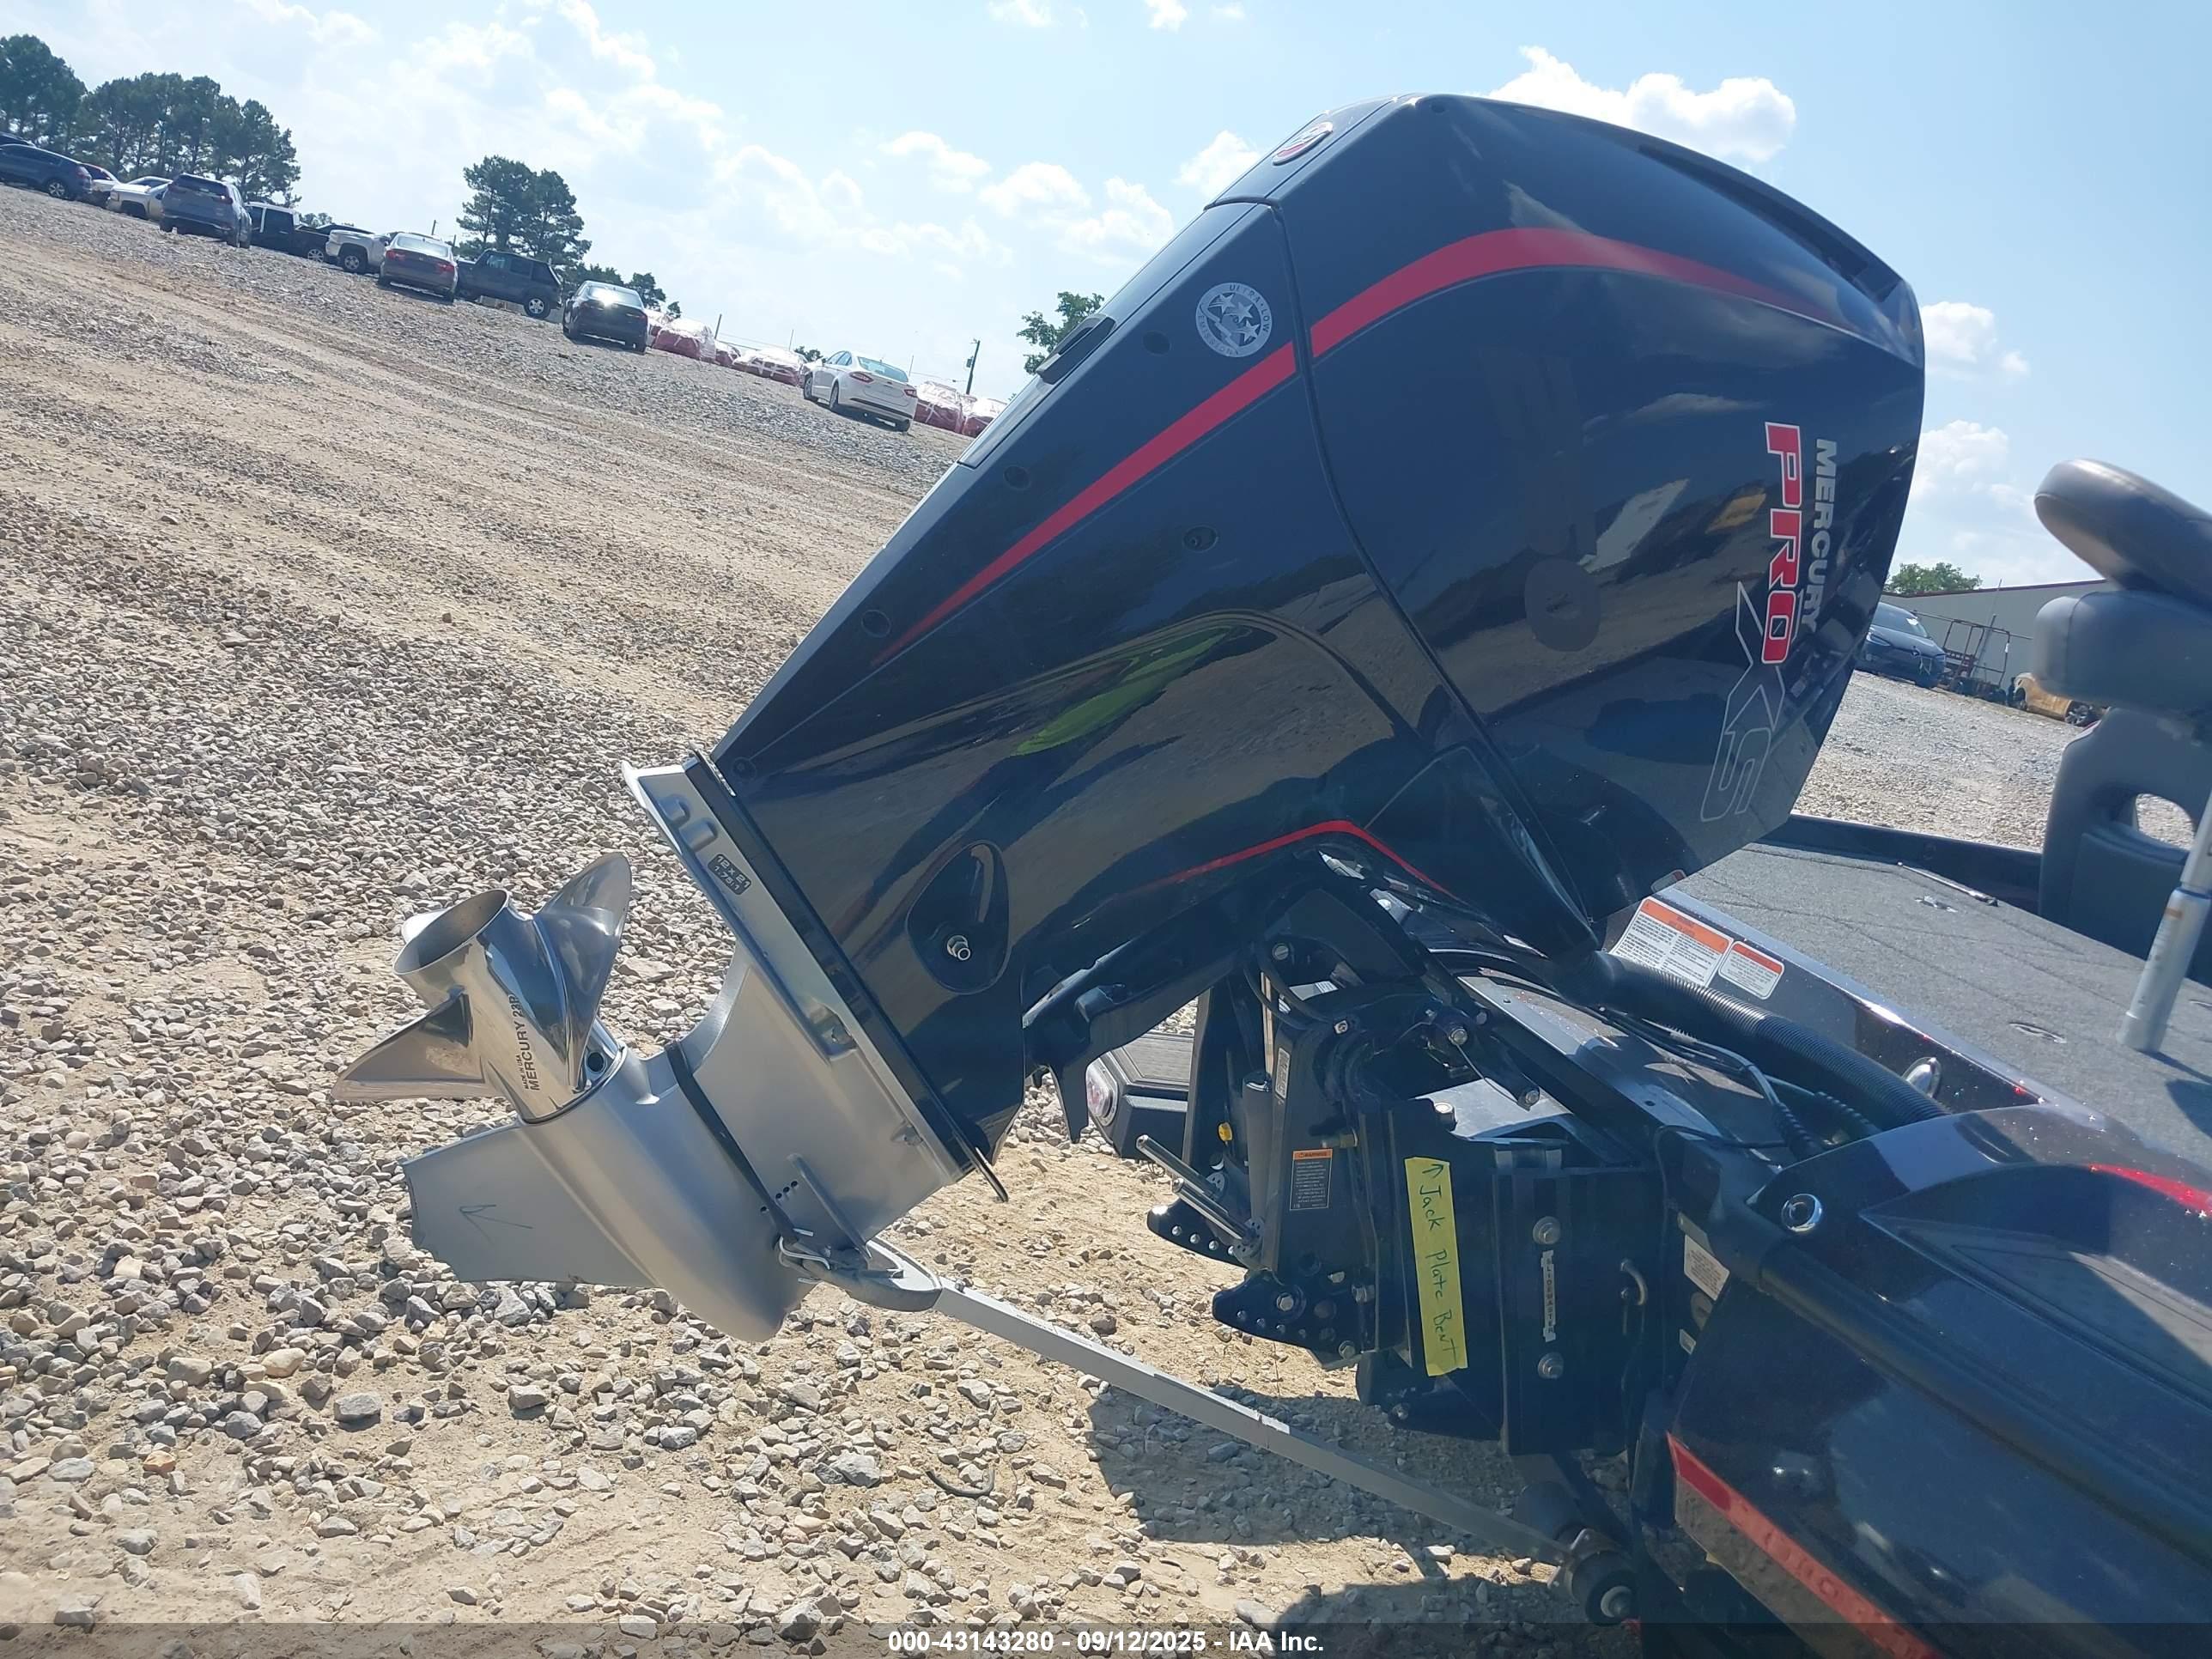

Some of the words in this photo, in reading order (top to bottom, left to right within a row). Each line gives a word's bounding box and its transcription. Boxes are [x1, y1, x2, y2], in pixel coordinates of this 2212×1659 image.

[1761, 422, 1803, 665] PRO
[1802, 439, 1838, 633] MERCURY
[1701, 581, 1803, 822] XS
[717, 857, 730, 869] 12
[736, 874, 750, 888] 21
[514, 1021, 540, 1091] MERCURY
[521, 1073, 530, 1089] MADE
[1419, 1184, 1445, 1231] Jack
[1425, 1248, 1450, 1298] Plate
